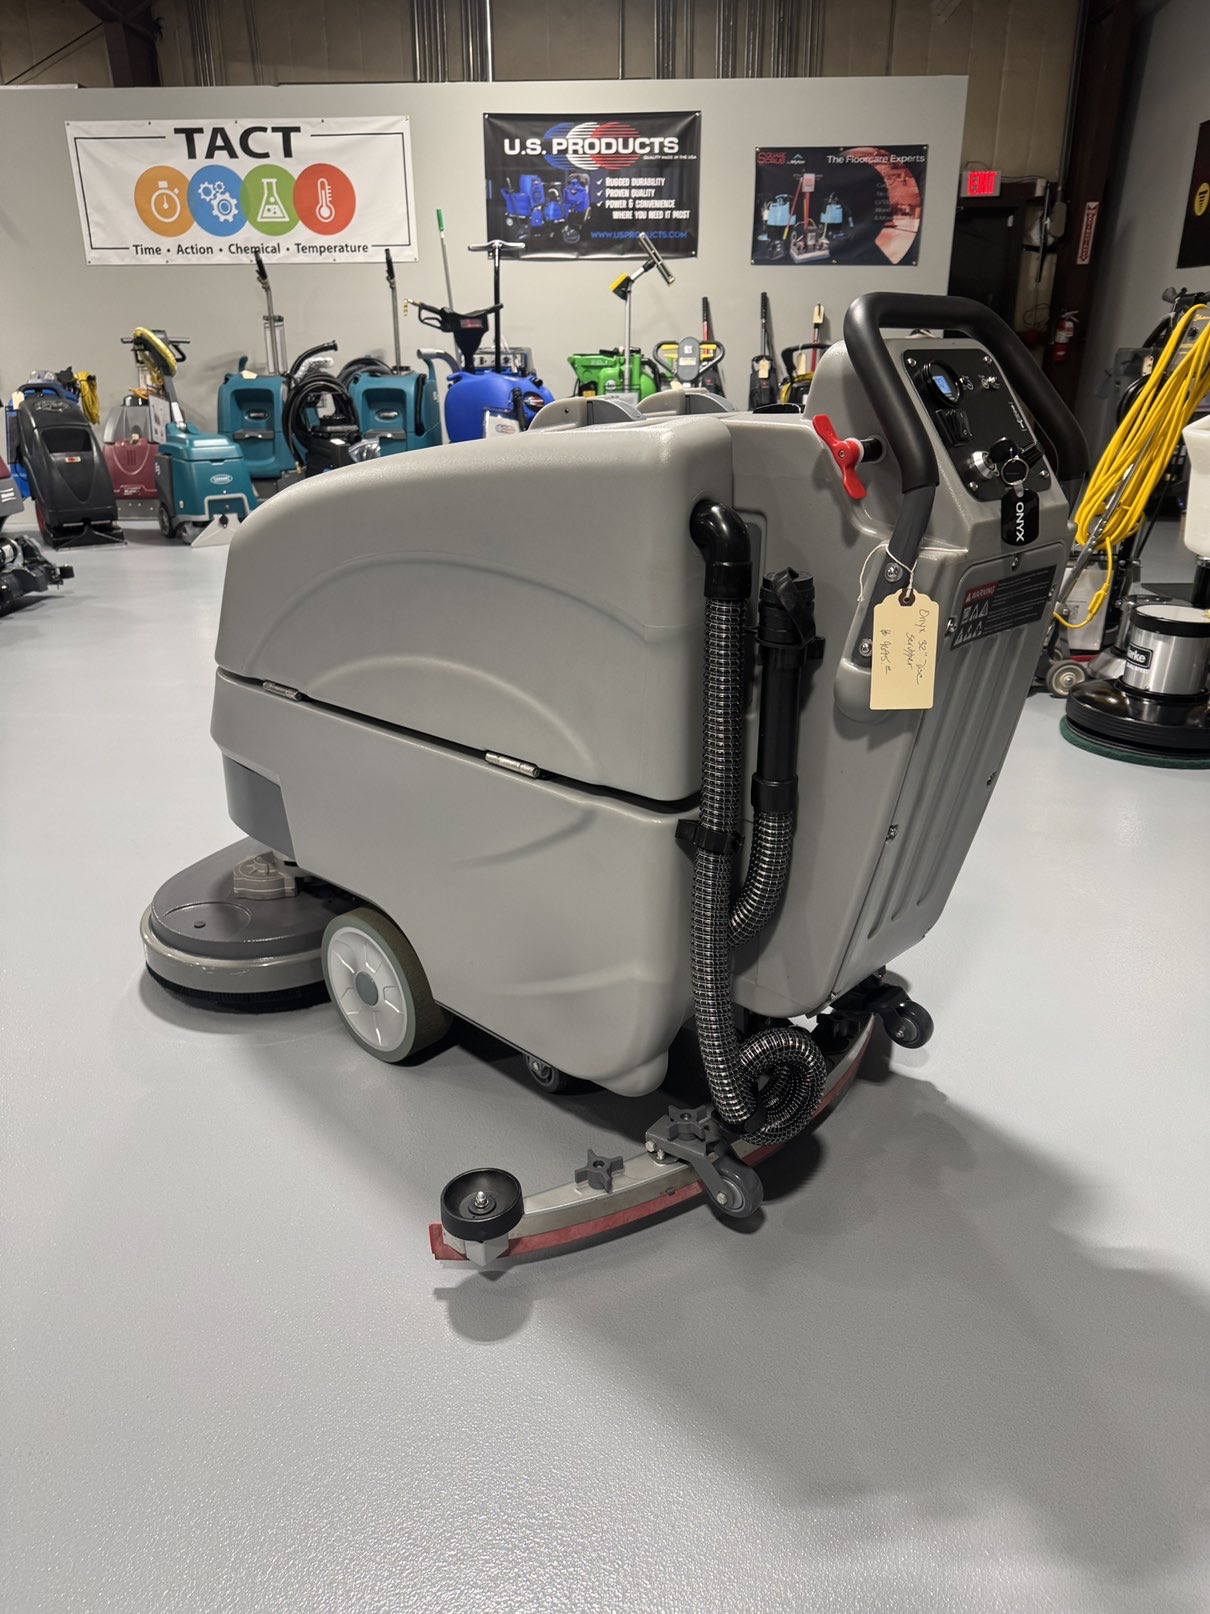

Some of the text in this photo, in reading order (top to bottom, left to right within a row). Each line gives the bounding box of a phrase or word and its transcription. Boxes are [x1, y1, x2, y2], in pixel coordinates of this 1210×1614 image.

[173, 126, 302, 160] TACT
[503, 137, 680, 156] U.S. PRODUCTS
[826, 154, 926, 164] The Floorcare Experts
[968, 171, 998, 196] EXIT
[605, 188, 656, 198] PROVEN QUALITY
[605, 199, 627, 209] POWER
[635, 199, 676, 209] CONVENIENCE
[612, 210, 691, 220] WHERE YOU NEED IT MOST
[591, 230, 689, 240] WWW.USPROUCTS.COM
[132, 242, 369, 256] Time Action Chemical Temperature
[1015, 501, 1025, 543] ONYX
[915, 608, 930, 634] Onyx
